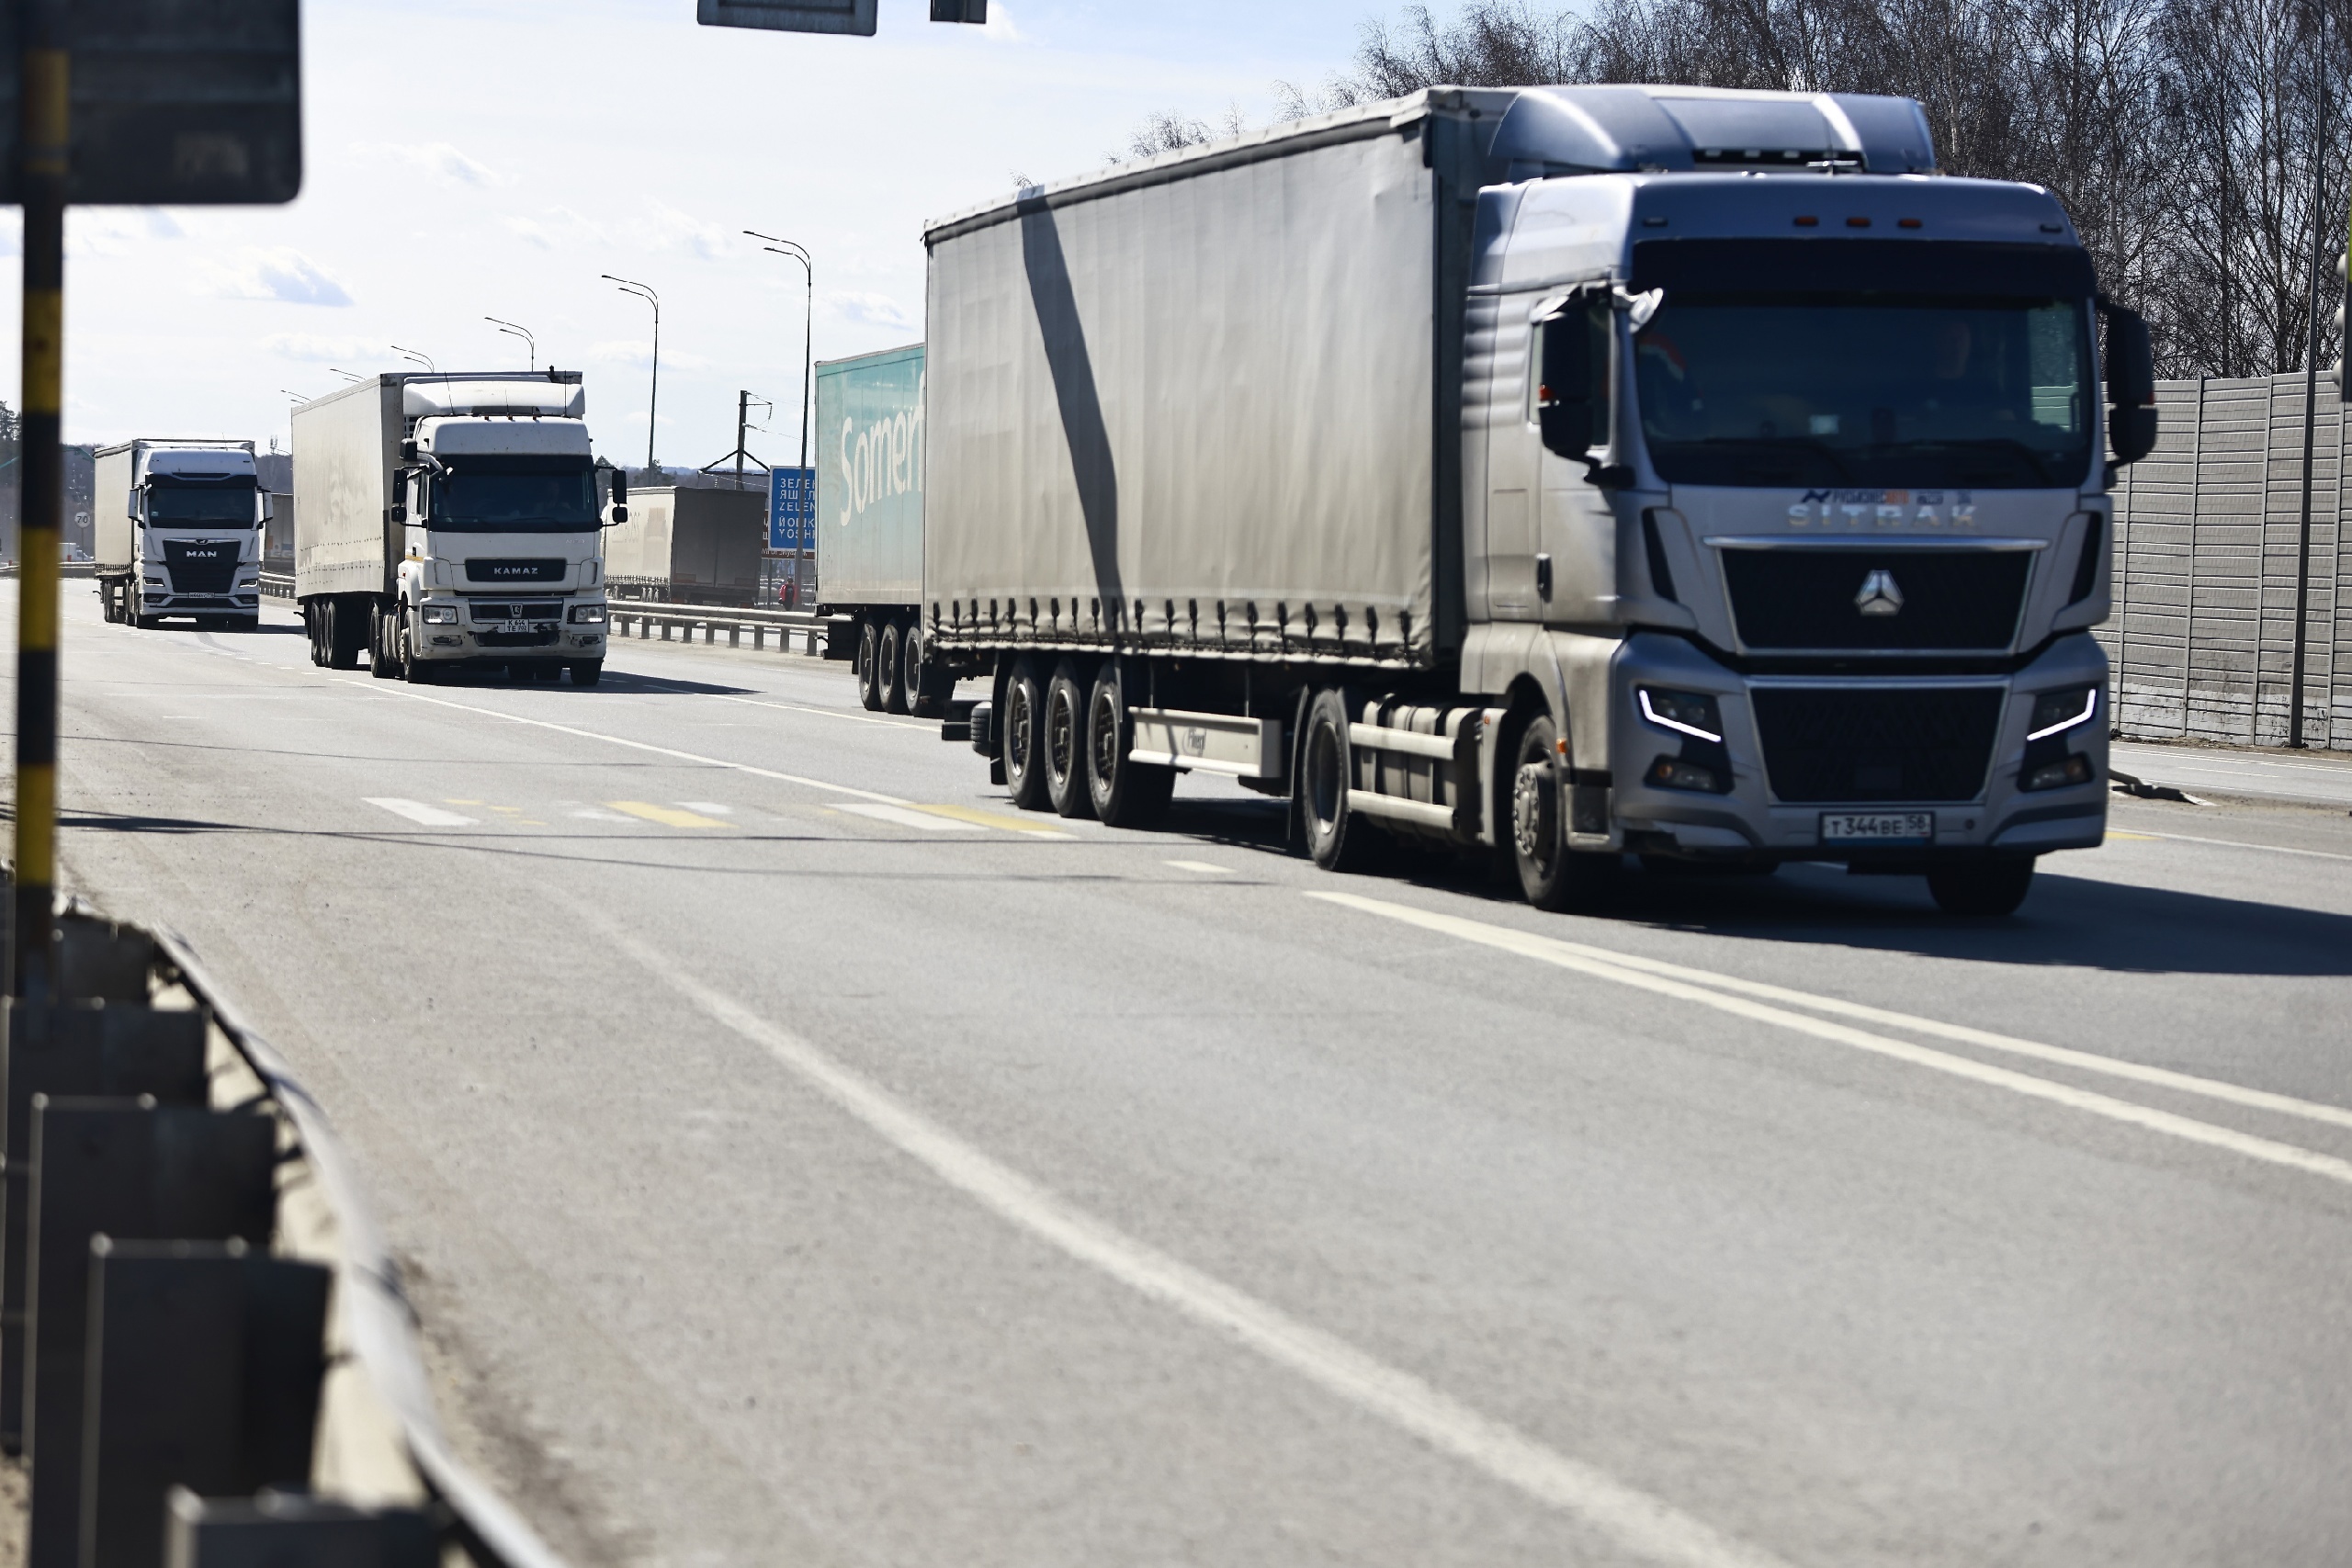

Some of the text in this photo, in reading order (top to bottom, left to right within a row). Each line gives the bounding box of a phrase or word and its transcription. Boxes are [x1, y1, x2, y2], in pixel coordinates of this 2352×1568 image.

[779, 490, 815, 501] ЯШЛ
[77, 515, 88, 524] 70
[1788, 505, 1978, 527] SITRAK
